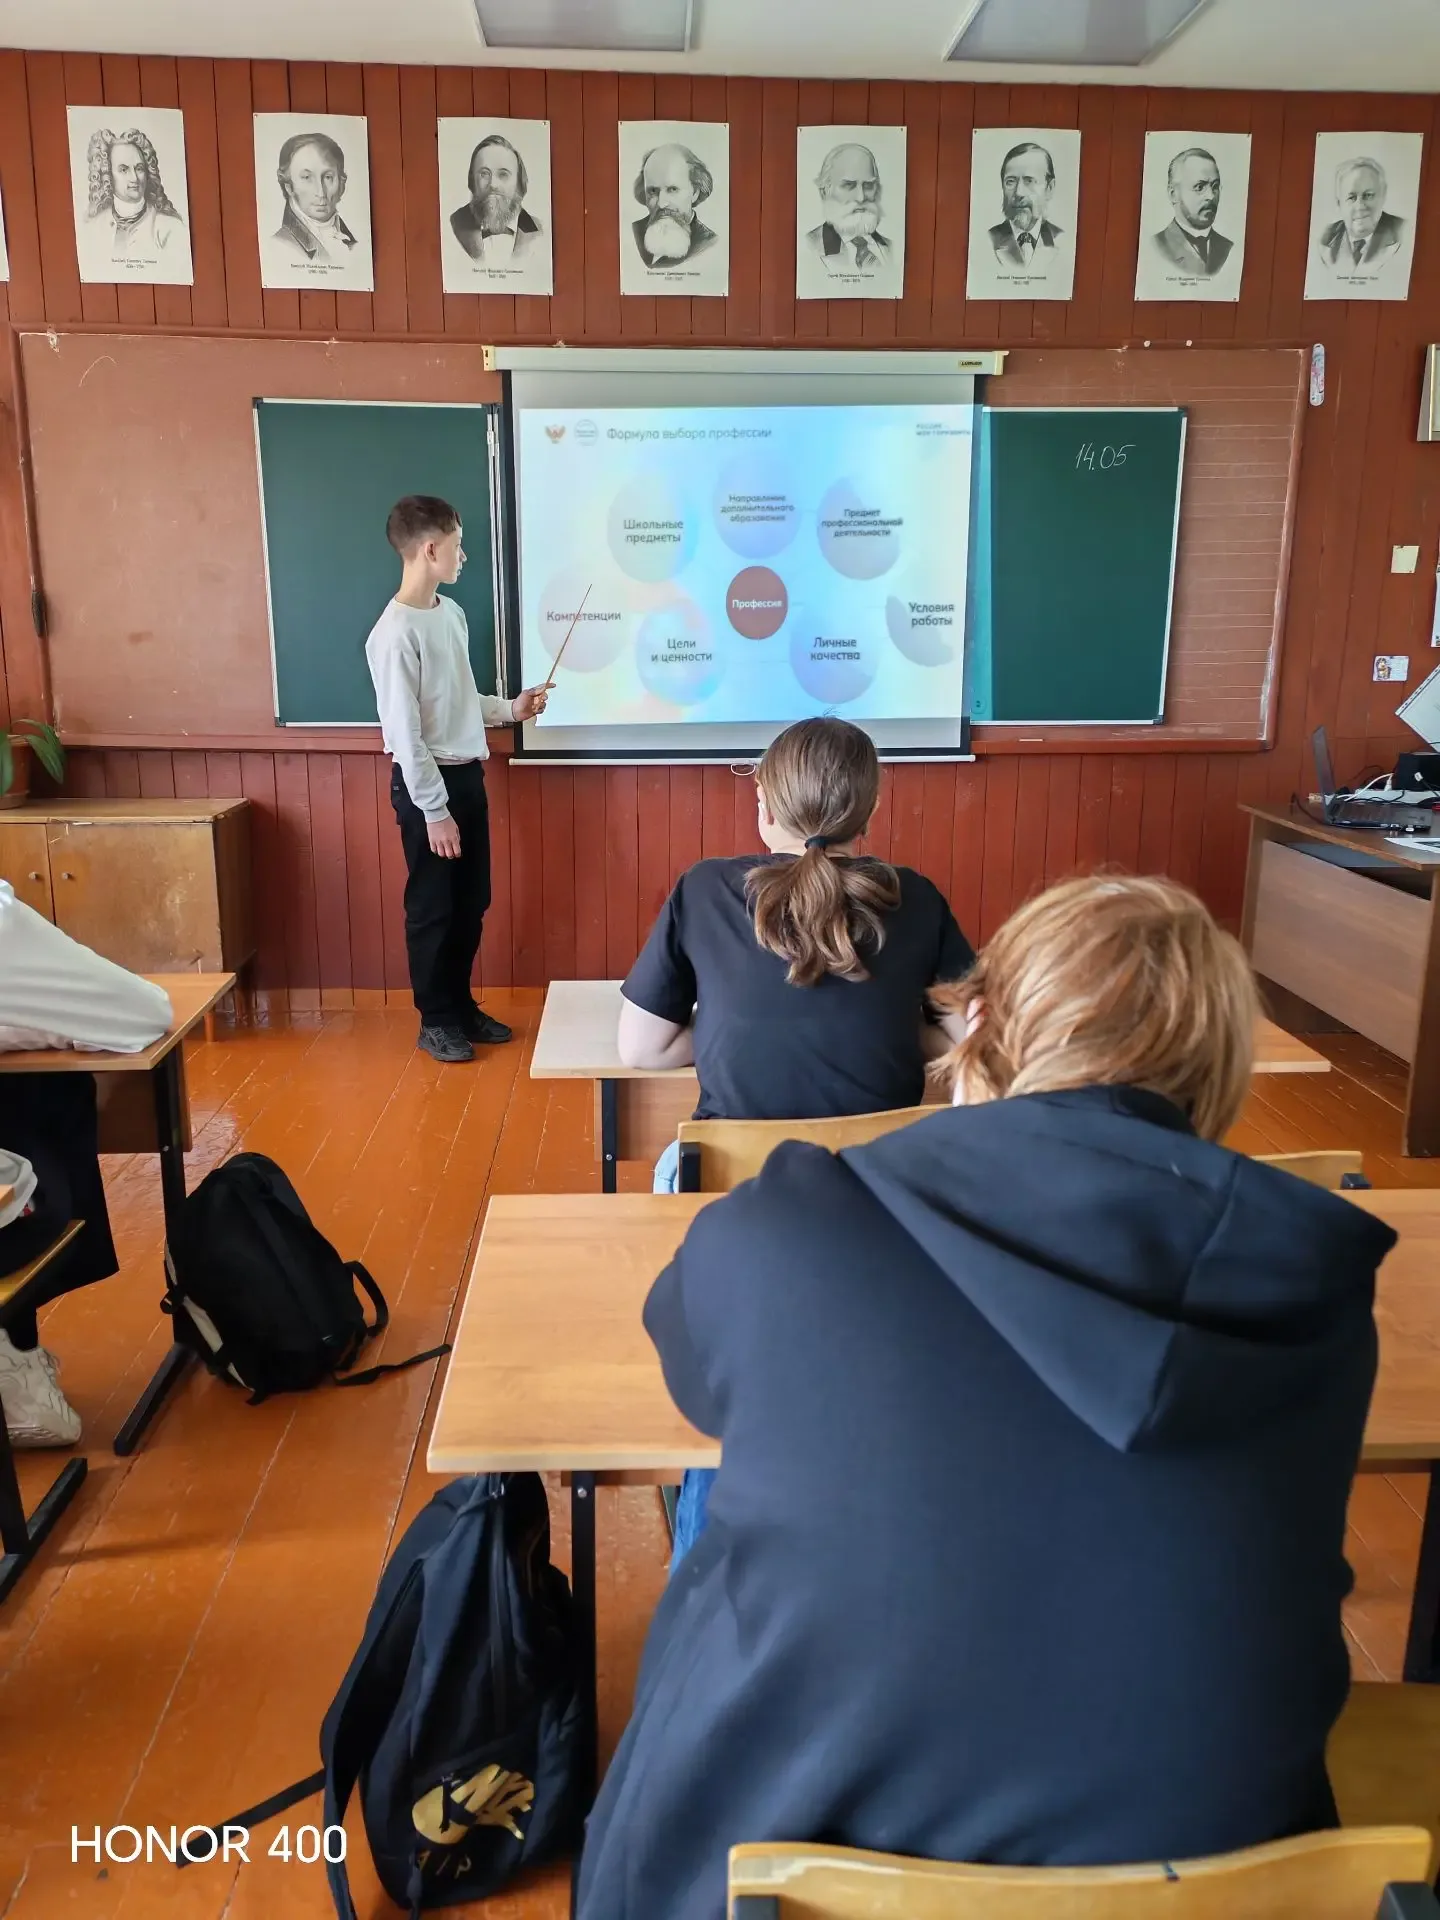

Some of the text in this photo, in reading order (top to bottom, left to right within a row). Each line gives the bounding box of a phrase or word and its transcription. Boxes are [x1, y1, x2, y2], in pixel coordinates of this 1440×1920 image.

[607, 427, 660, 442] Формула
[663, 427, 706, 439] выбора
[709, 426, 772, 441] профессии
[1075, 442, 1137, 471] 14.05
[729, 494, 786, 503] Направление
[720, 504, 795, 513] дополнительного
[844, 508, 881, 518] Предмет
[730, 513, 786, 523] образования
[821, 517, 904, 528] профессиональной
[623, 519, 684, 530] Школьные
[625, 533, 682, 545] предметы
[833, 529, 892, 539] деятельности
[732, 598, 783, 610] Профессия
[909, 602, 955, 613] Условия
[546, 610, 622, 623] Компетенции
[911, 615, 953, 629] работы
[667, 638, 697, 650] Цели
[813, 637, 858, 649] Личные
[651, 652, 713, 664] и ценности
[810, 650, 861, 661] качества
